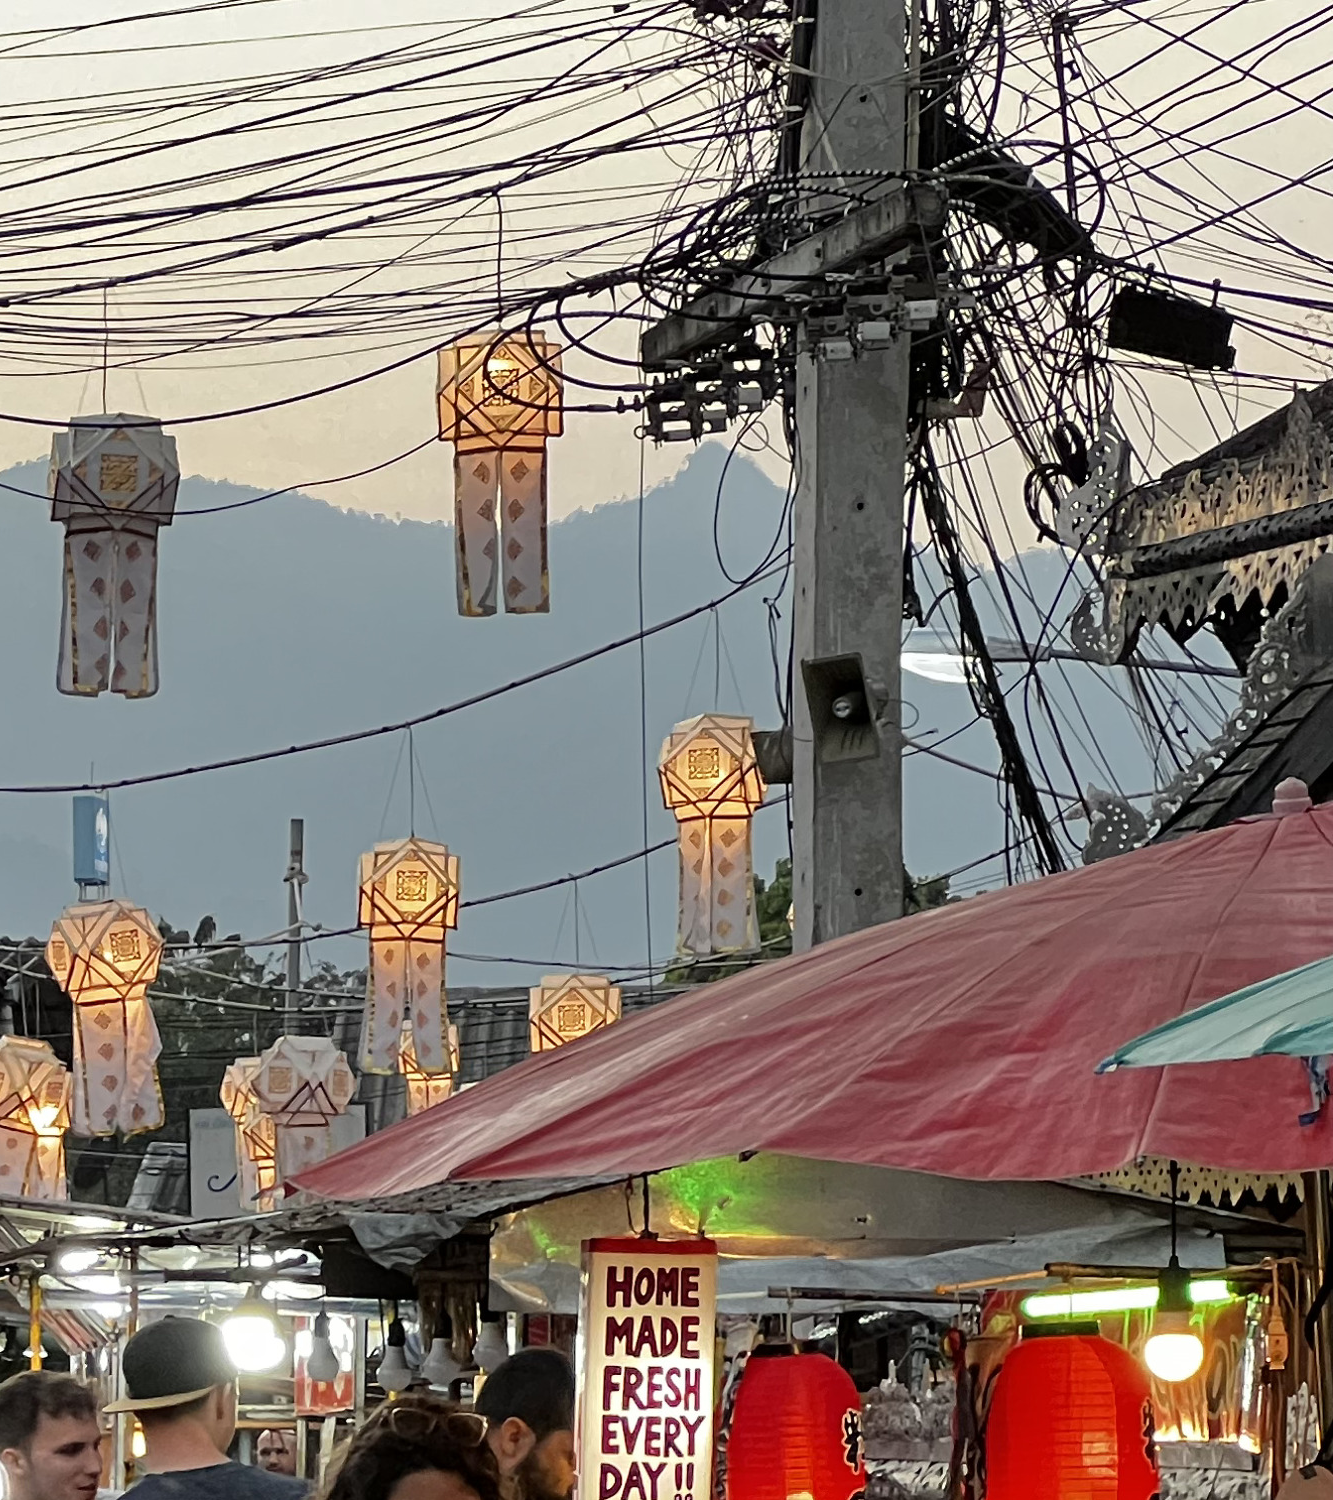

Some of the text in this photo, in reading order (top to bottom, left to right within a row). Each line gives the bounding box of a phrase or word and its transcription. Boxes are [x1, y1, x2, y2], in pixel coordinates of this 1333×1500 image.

[606, 1266, 700, 1308] HOME
[604, 1315, 700, 1359] MADE
[602, 1365, 701, 1411] FRESH
[601, 1415, 705, 1458] EVERY
